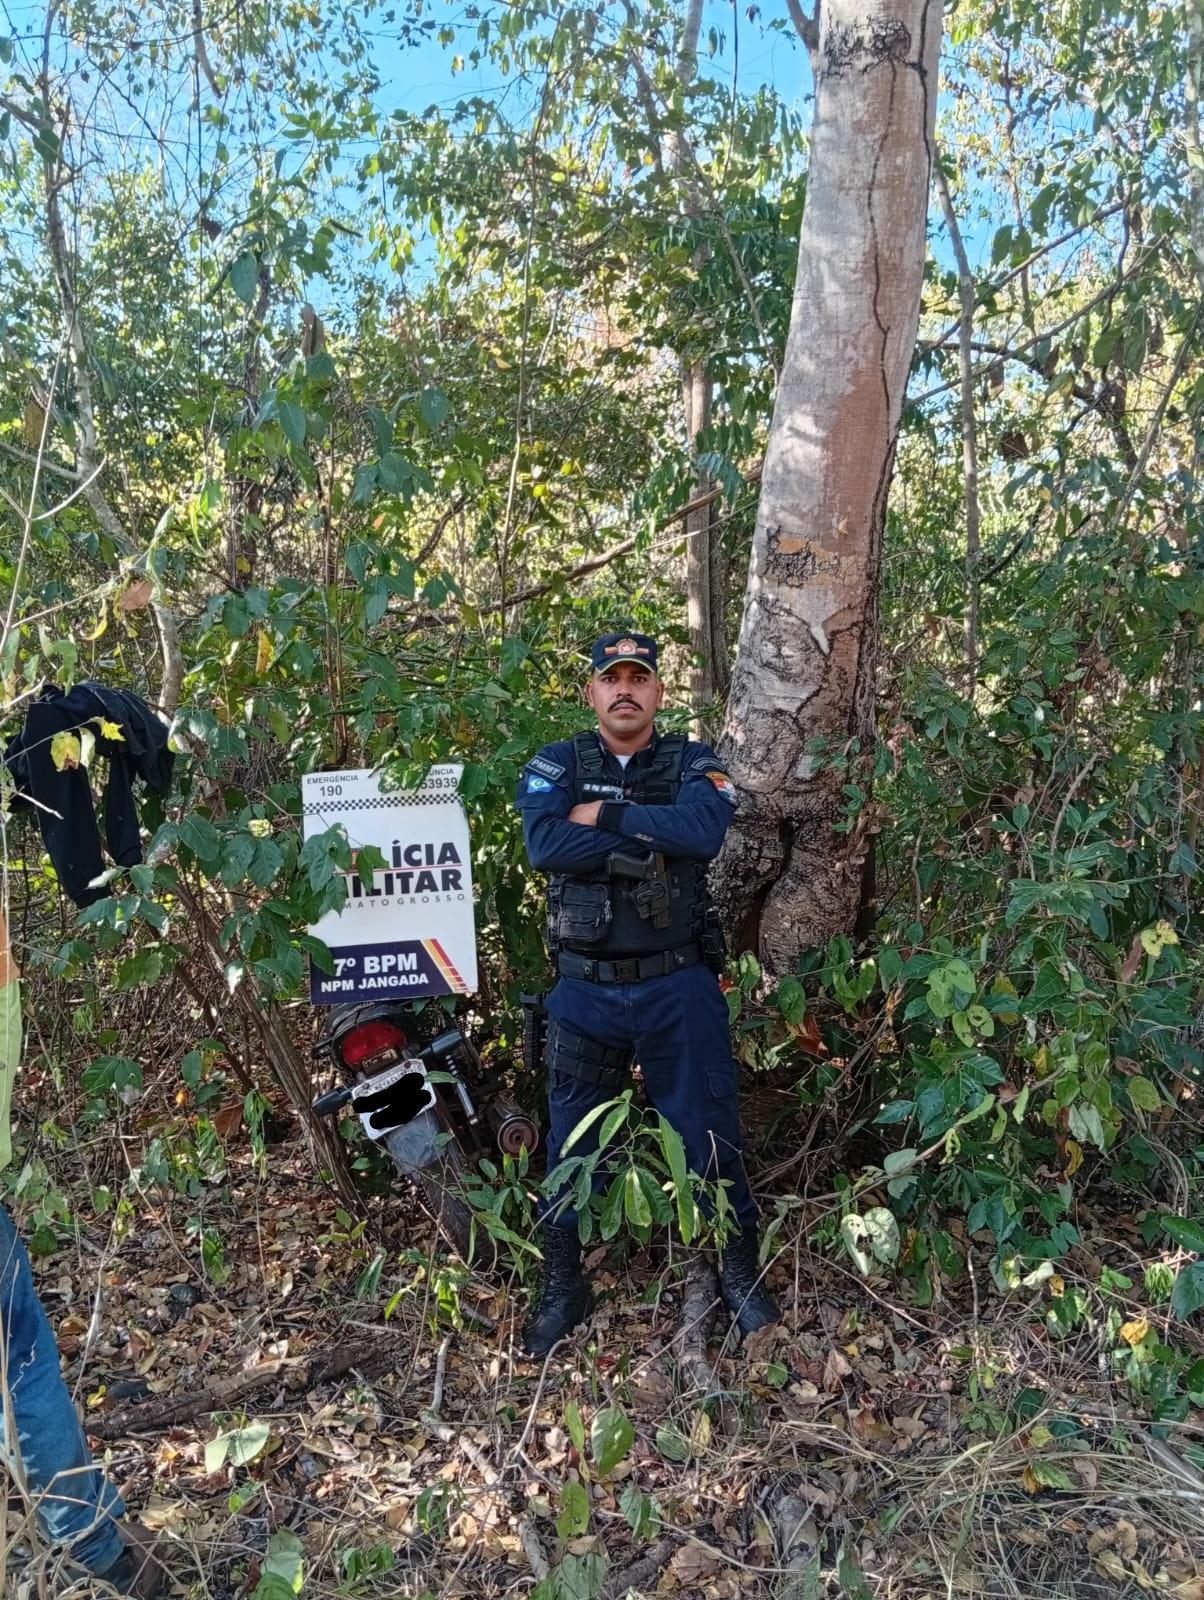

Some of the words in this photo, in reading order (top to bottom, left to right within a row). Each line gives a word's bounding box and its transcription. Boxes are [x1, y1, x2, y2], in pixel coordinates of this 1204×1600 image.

[531, 759, 560, 775] PMMT
[320, 785, 342, 796] 190
[392, 839, 461, 868] ÍCIA
[344, 869, 463, 898] ILITAR
[364, 953, 417, 974] BPM
[321, 979, 354, 993] NPM
[358, 973, 429, 990] JANGADA
